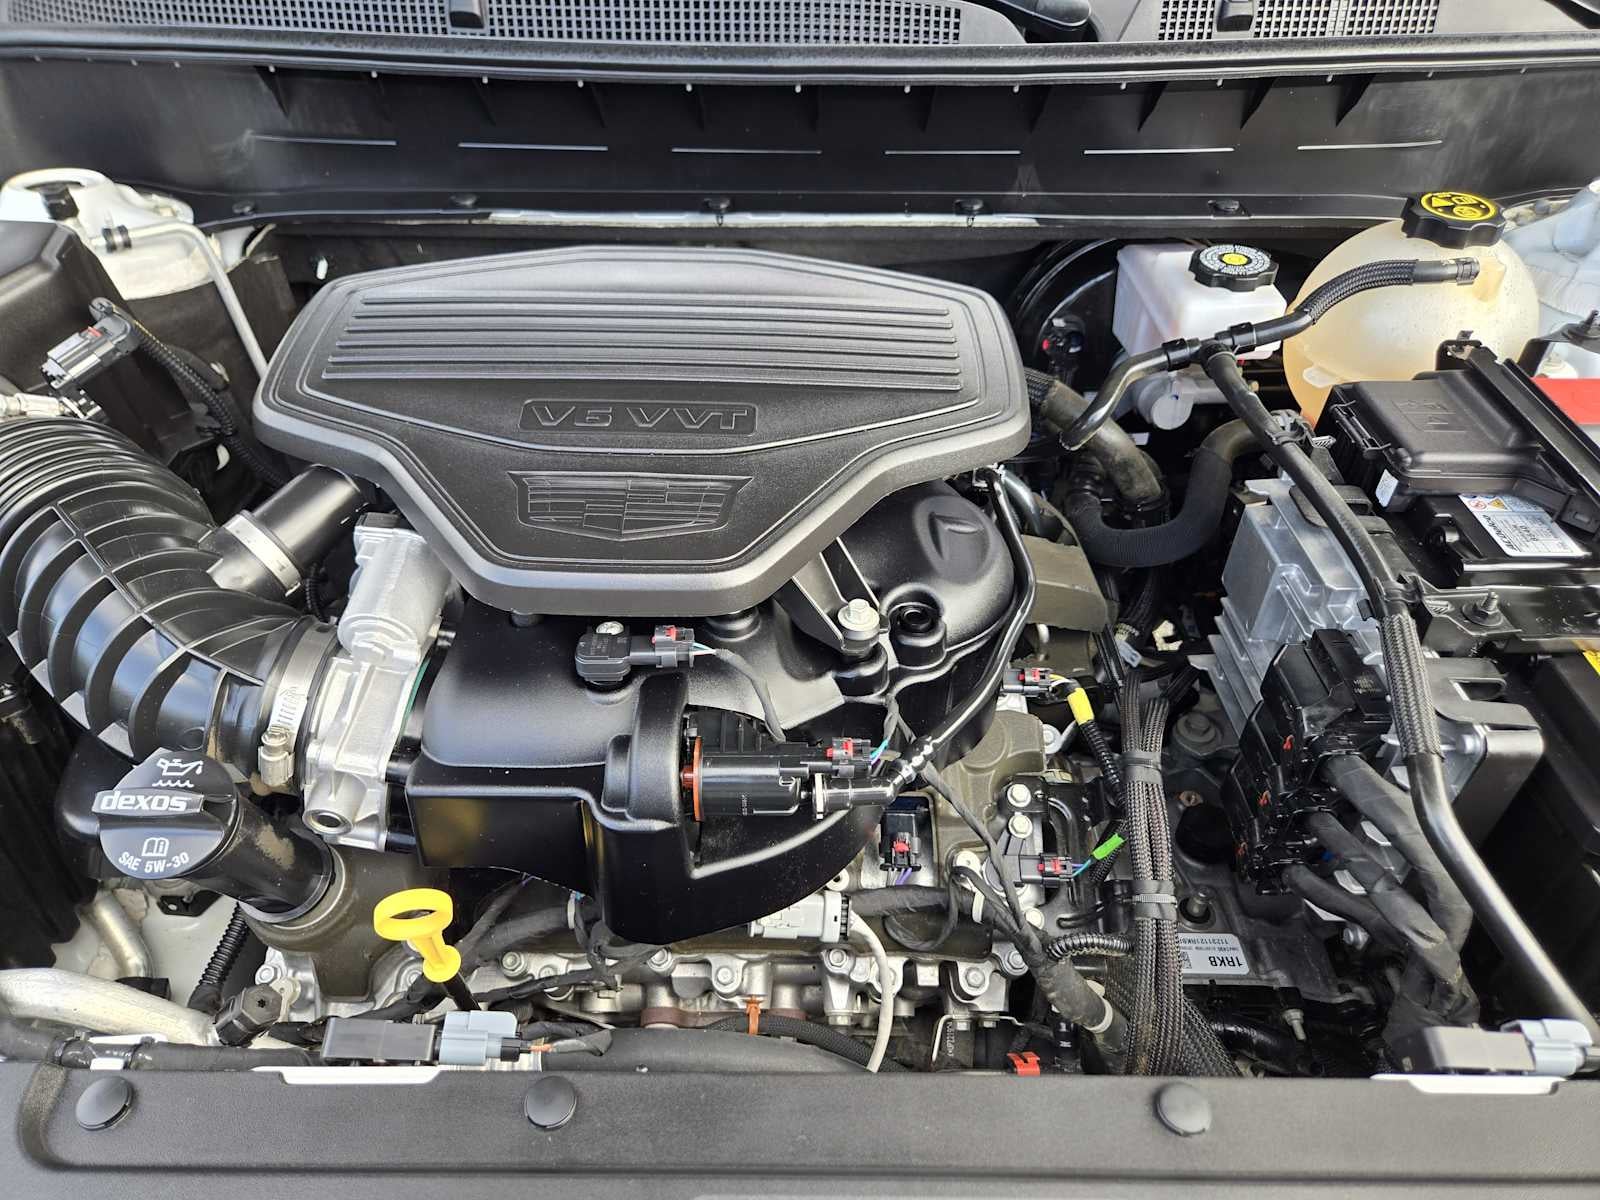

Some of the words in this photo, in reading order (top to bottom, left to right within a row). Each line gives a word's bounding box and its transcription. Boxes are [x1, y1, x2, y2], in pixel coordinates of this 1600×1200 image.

[532, 405, 613, 427] V6
[626, 406, 748, 430] VVT
[100, 790, 190, 812] dexos
[118, 851, 141, 871] SAE
[144, 851, 189, 873] 5W-30
[1208, 955, 1243, 967] 1RKB
